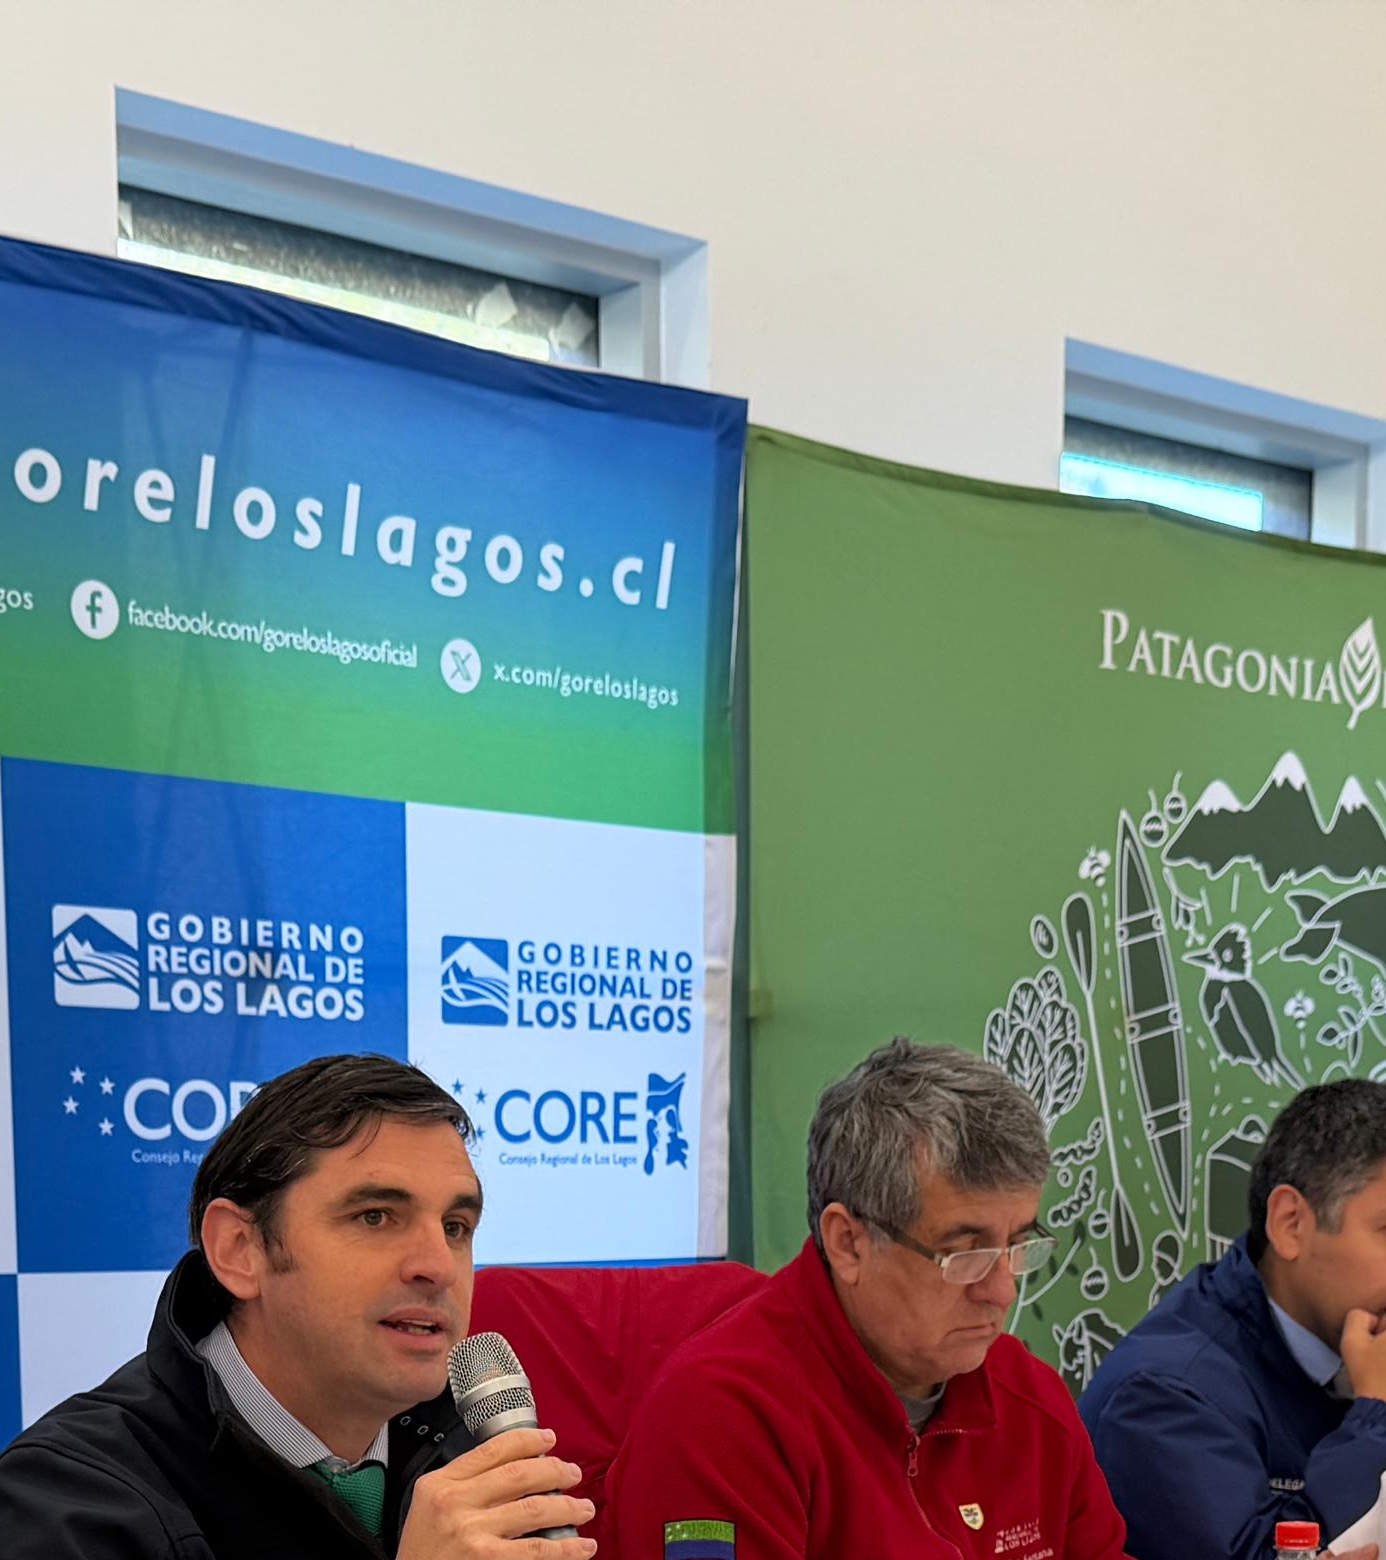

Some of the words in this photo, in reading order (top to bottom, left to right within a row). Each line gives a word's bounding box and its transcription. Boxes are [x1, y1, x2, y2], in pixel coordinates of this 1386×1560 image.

[128, 600, 417, 669] facebook.com/goreloslagosoficial
[493, 661, 679, 710] x.com/goreloslagos
[147, 912, 362, 953] GOBIERNO
[148, 946, 315, 982] REGIONAL
[325, 956, 364, 984] DE
[517, 941, 692, 974] GOBIERNO
[148, 978, 223, 1015] LOS
[236, 982, 364, 1021] LAGOS
[517, 971, 651, 999] REGIONAL
[662, 978, 692, 1001] DE
[517, 999, 576, 1030] LOS
[589, 1003, 691, 1034] LAGOS
[494, 1089, 638, 1144] CORE
[132, 1149, 179, 1166] Consejo
[499, 1153, 537, 1168] Consejo
[541, 1153, 579, 1169] Regional
[582, 1153, 592, 1165] de
[595, 1153, 610, 1165] Los
[613, 1154, 637, 1168] Lagos
